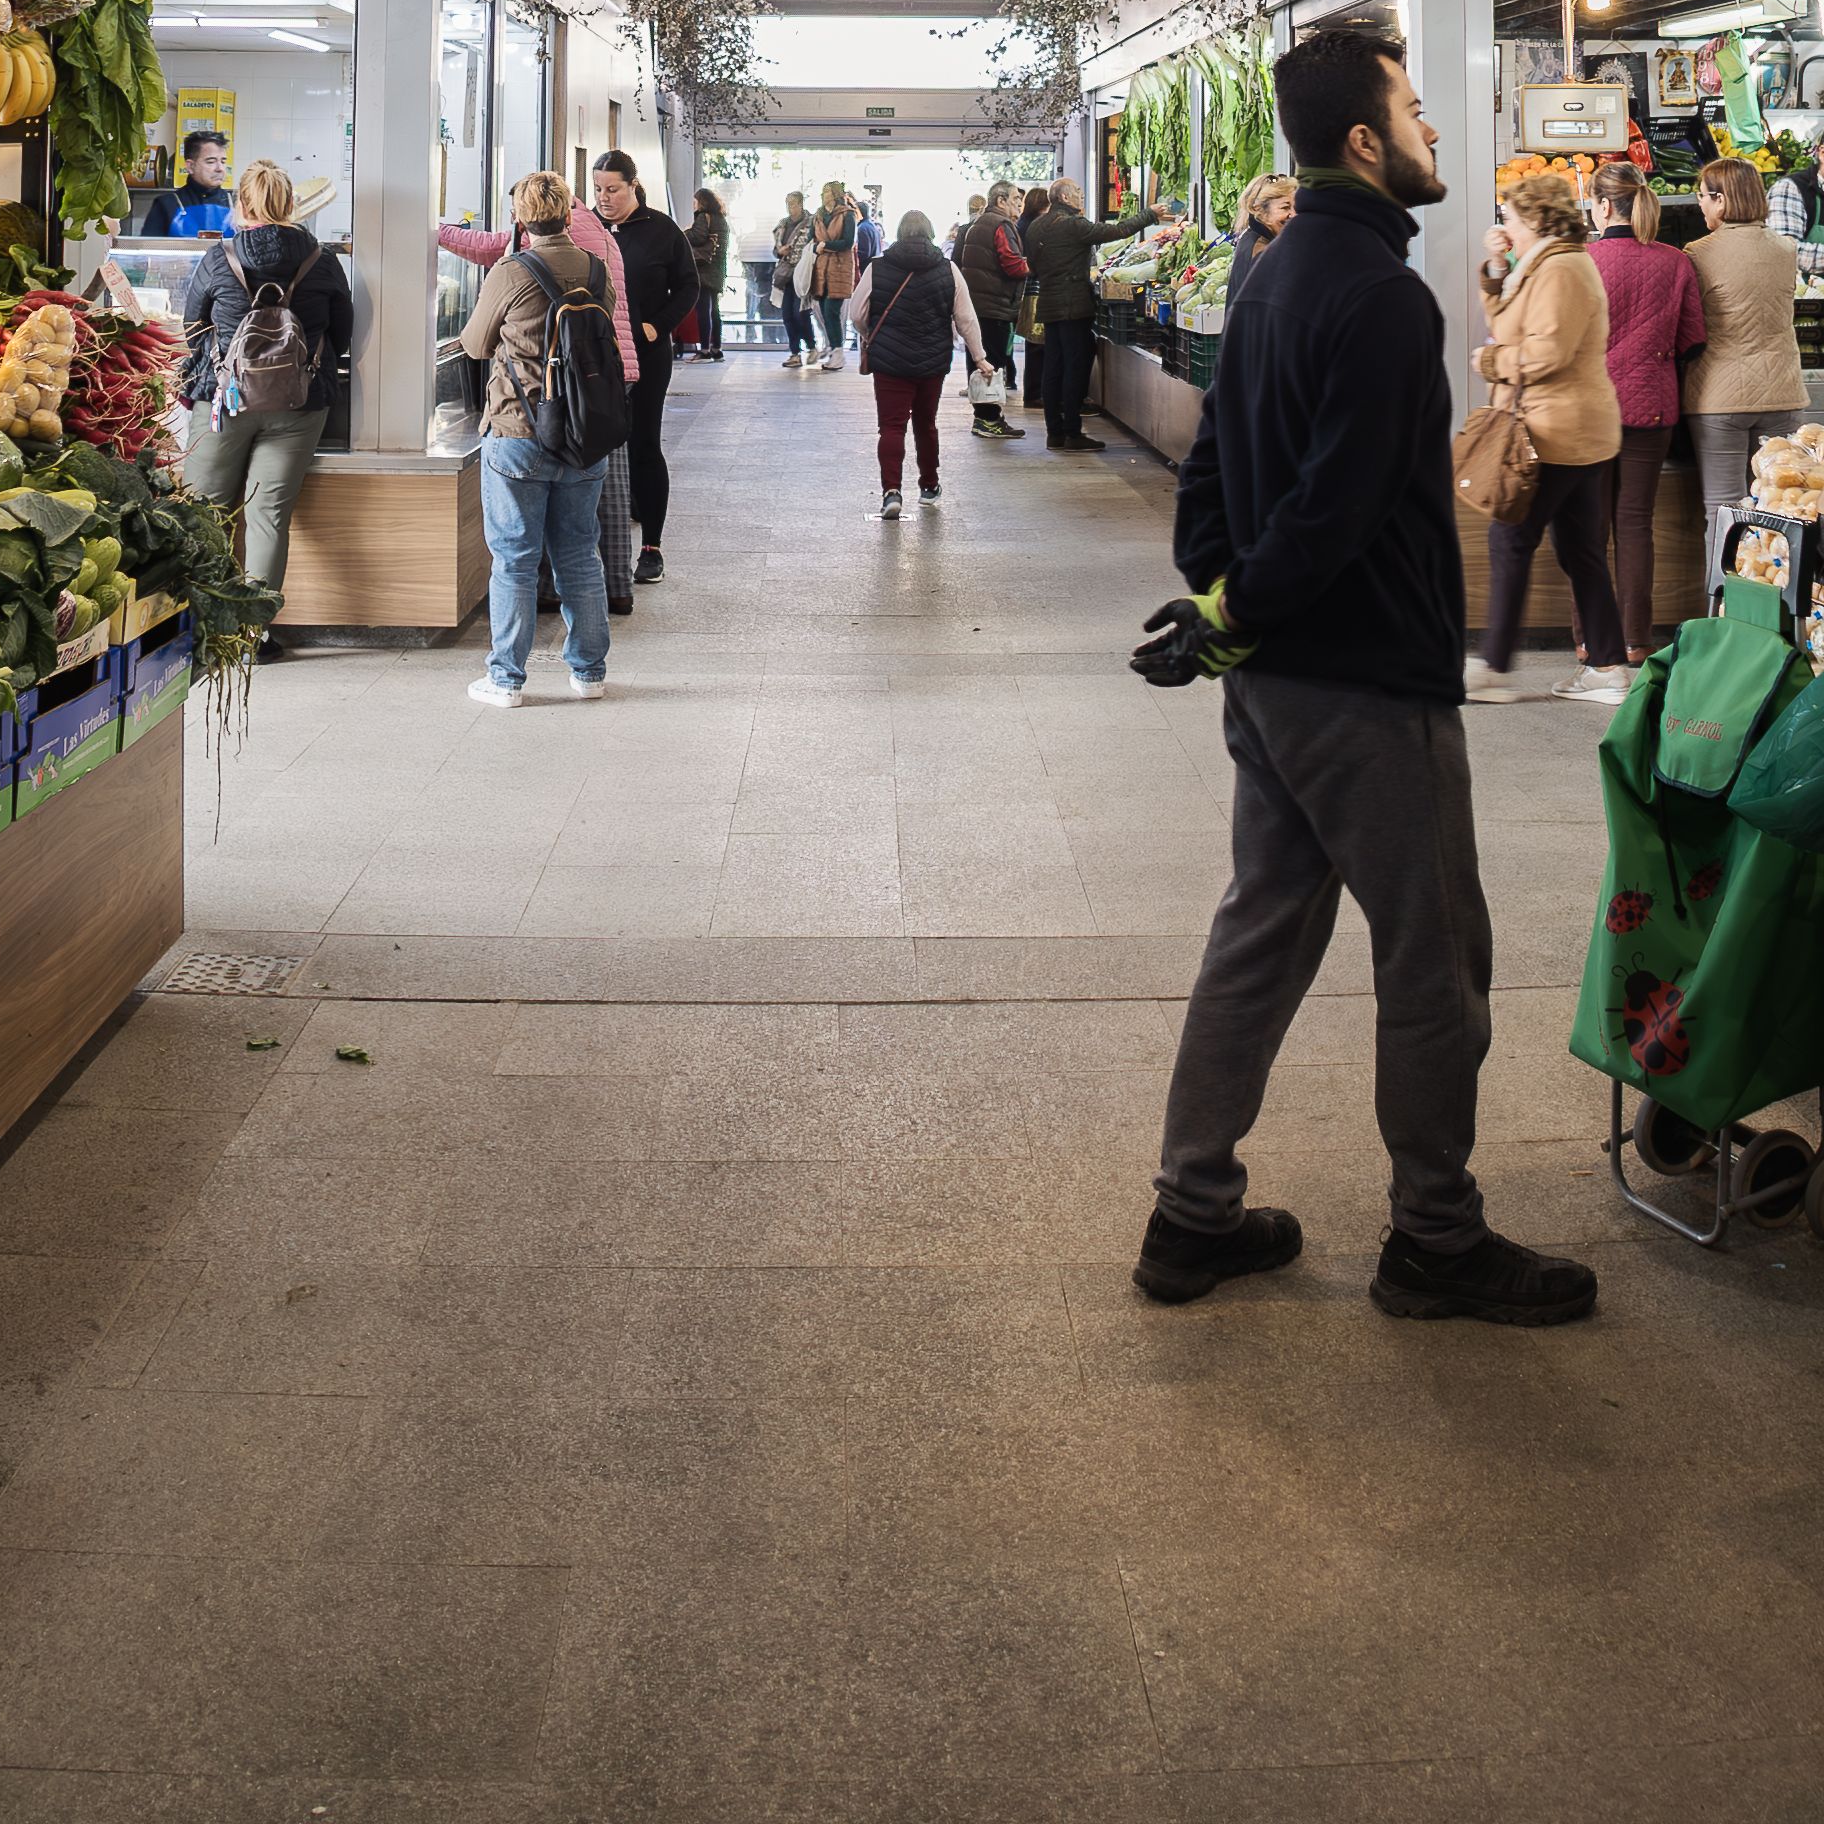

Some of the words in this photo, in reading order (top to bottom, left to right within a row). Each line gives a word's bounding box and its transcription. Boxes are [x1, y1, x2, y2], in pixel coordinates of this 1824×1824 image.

[867, 108, 894, 117] SALIDA
[62, 732, 79, 758] Las
[79, 705, 110, 747] Virtudes
